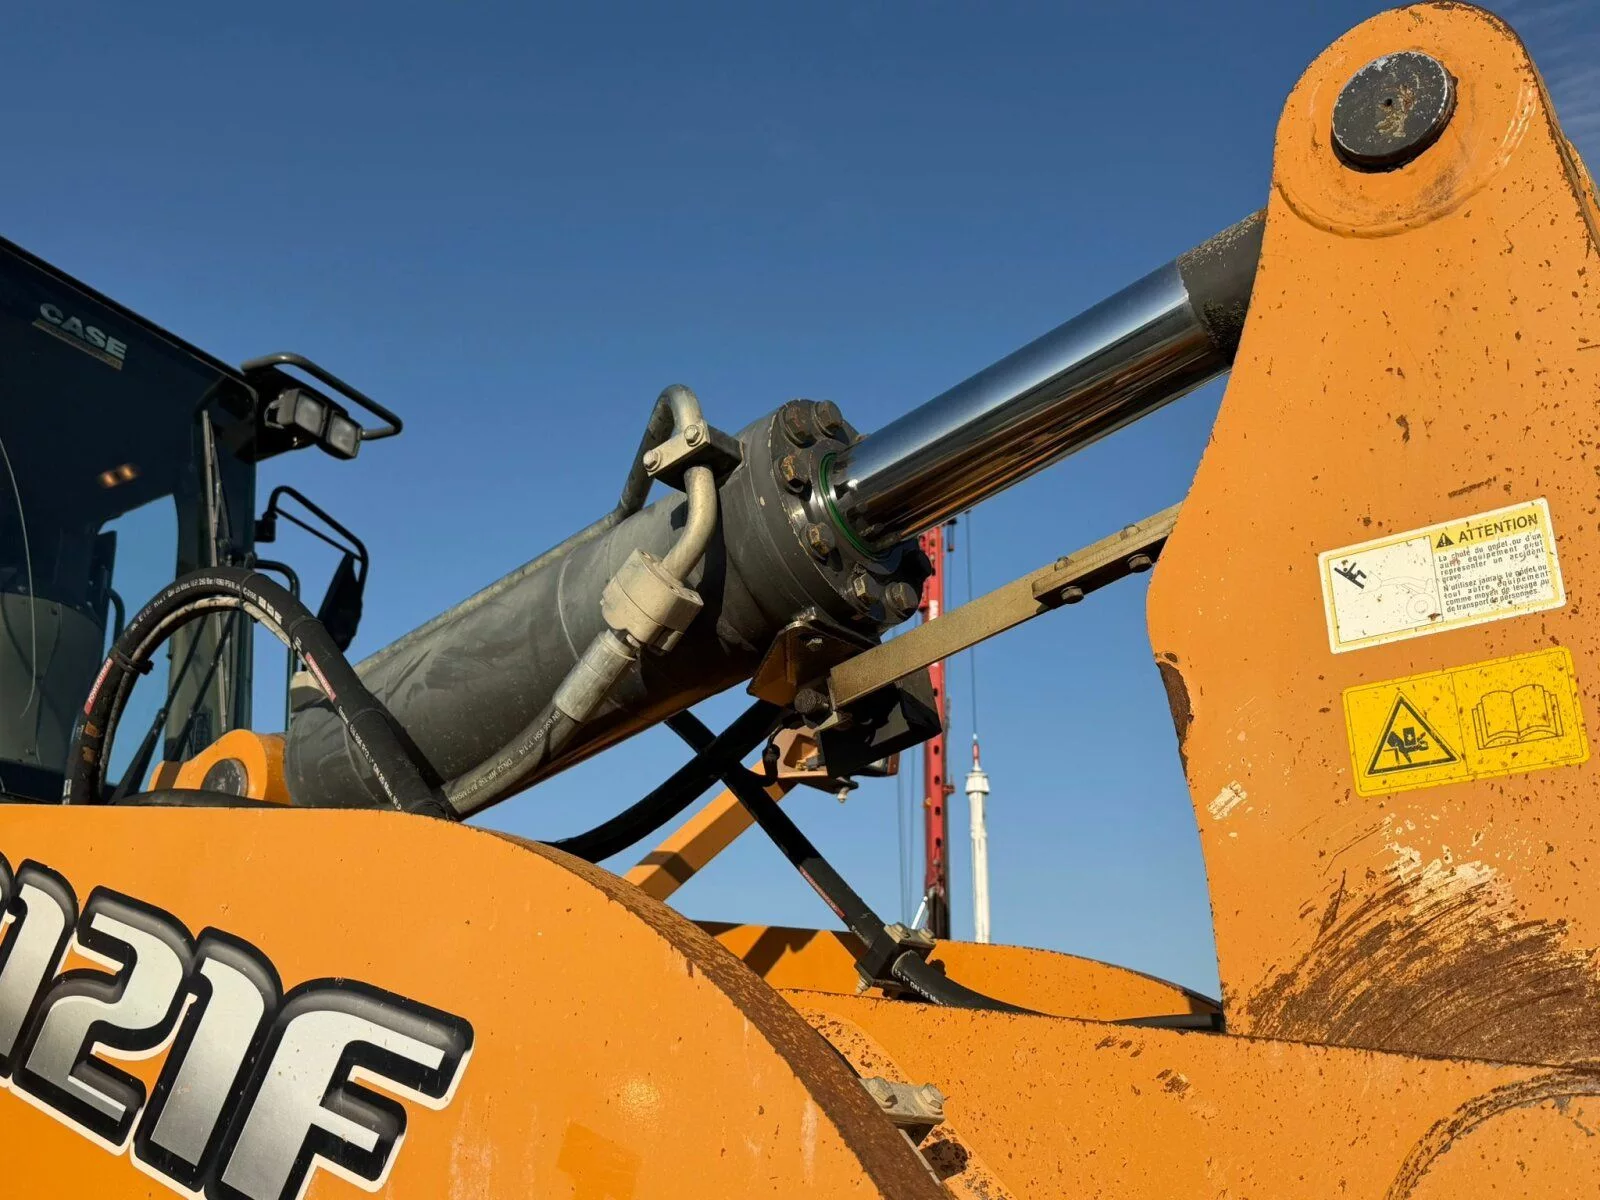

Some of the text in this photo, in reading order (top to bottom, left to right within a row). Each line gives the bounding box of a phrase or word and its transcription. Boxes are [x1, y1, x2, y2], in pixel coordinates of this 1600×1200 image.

[39, 302, 128, 361] CASE
[1458, 513, 1538, 543] ATTENTION
[0, 850, 475, 1200] 121F
